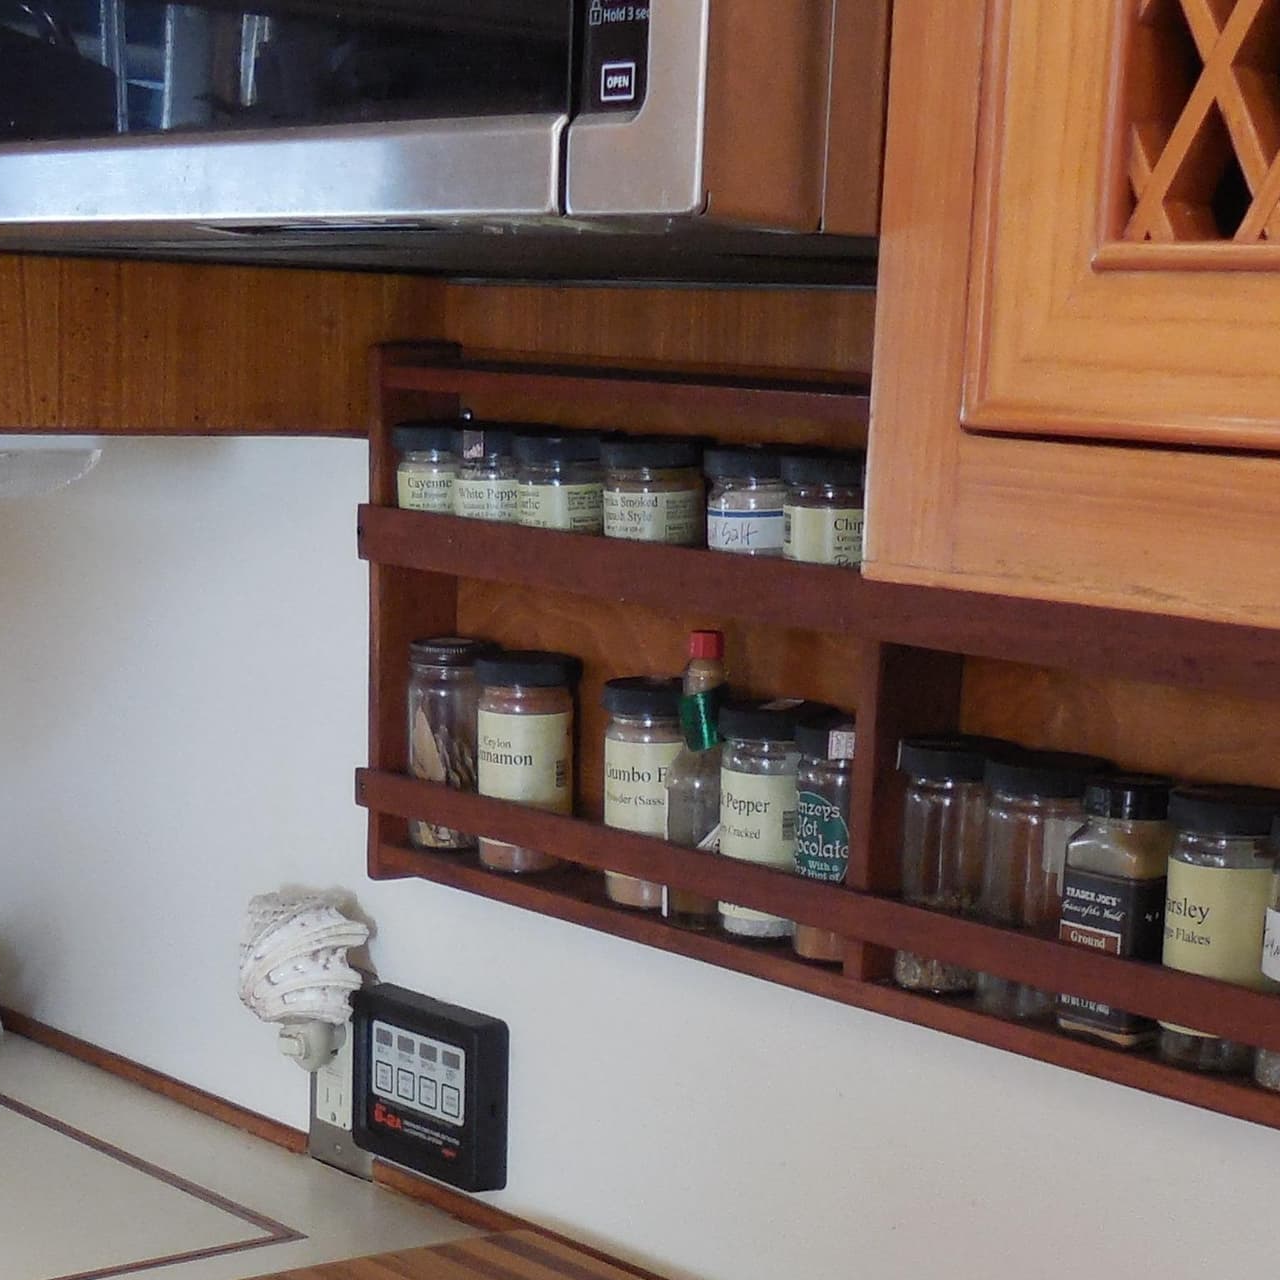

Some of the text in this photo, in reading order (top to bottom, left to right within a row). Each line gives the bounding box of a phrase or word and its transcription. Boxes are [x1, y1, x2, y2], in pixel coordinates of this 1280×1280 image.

[603, 6, 625, 22] Hold
[627, 6, 634, 21] 3
[606, 75, 629, 89] OPEN
[407, 476, 453, 491] Cayenne
[459, 487, 484, 500] White
[620, 495, 658, 508] Smoked
[483, 735, 512, 750] Ceylon
[727, 792, 771, 816] Pepper
[799, 801, 841, 822] nzeys
[728, 825, 761, 840] Cracked
[798, 834, 849, 858] ocolate
[1066, 886, 1096, 902] TRADER
[1166, 897, 1210, 926] rsley
[1070, 930, 1106, 950] Ground
[1175, 927, 1212, 946] Flakes
